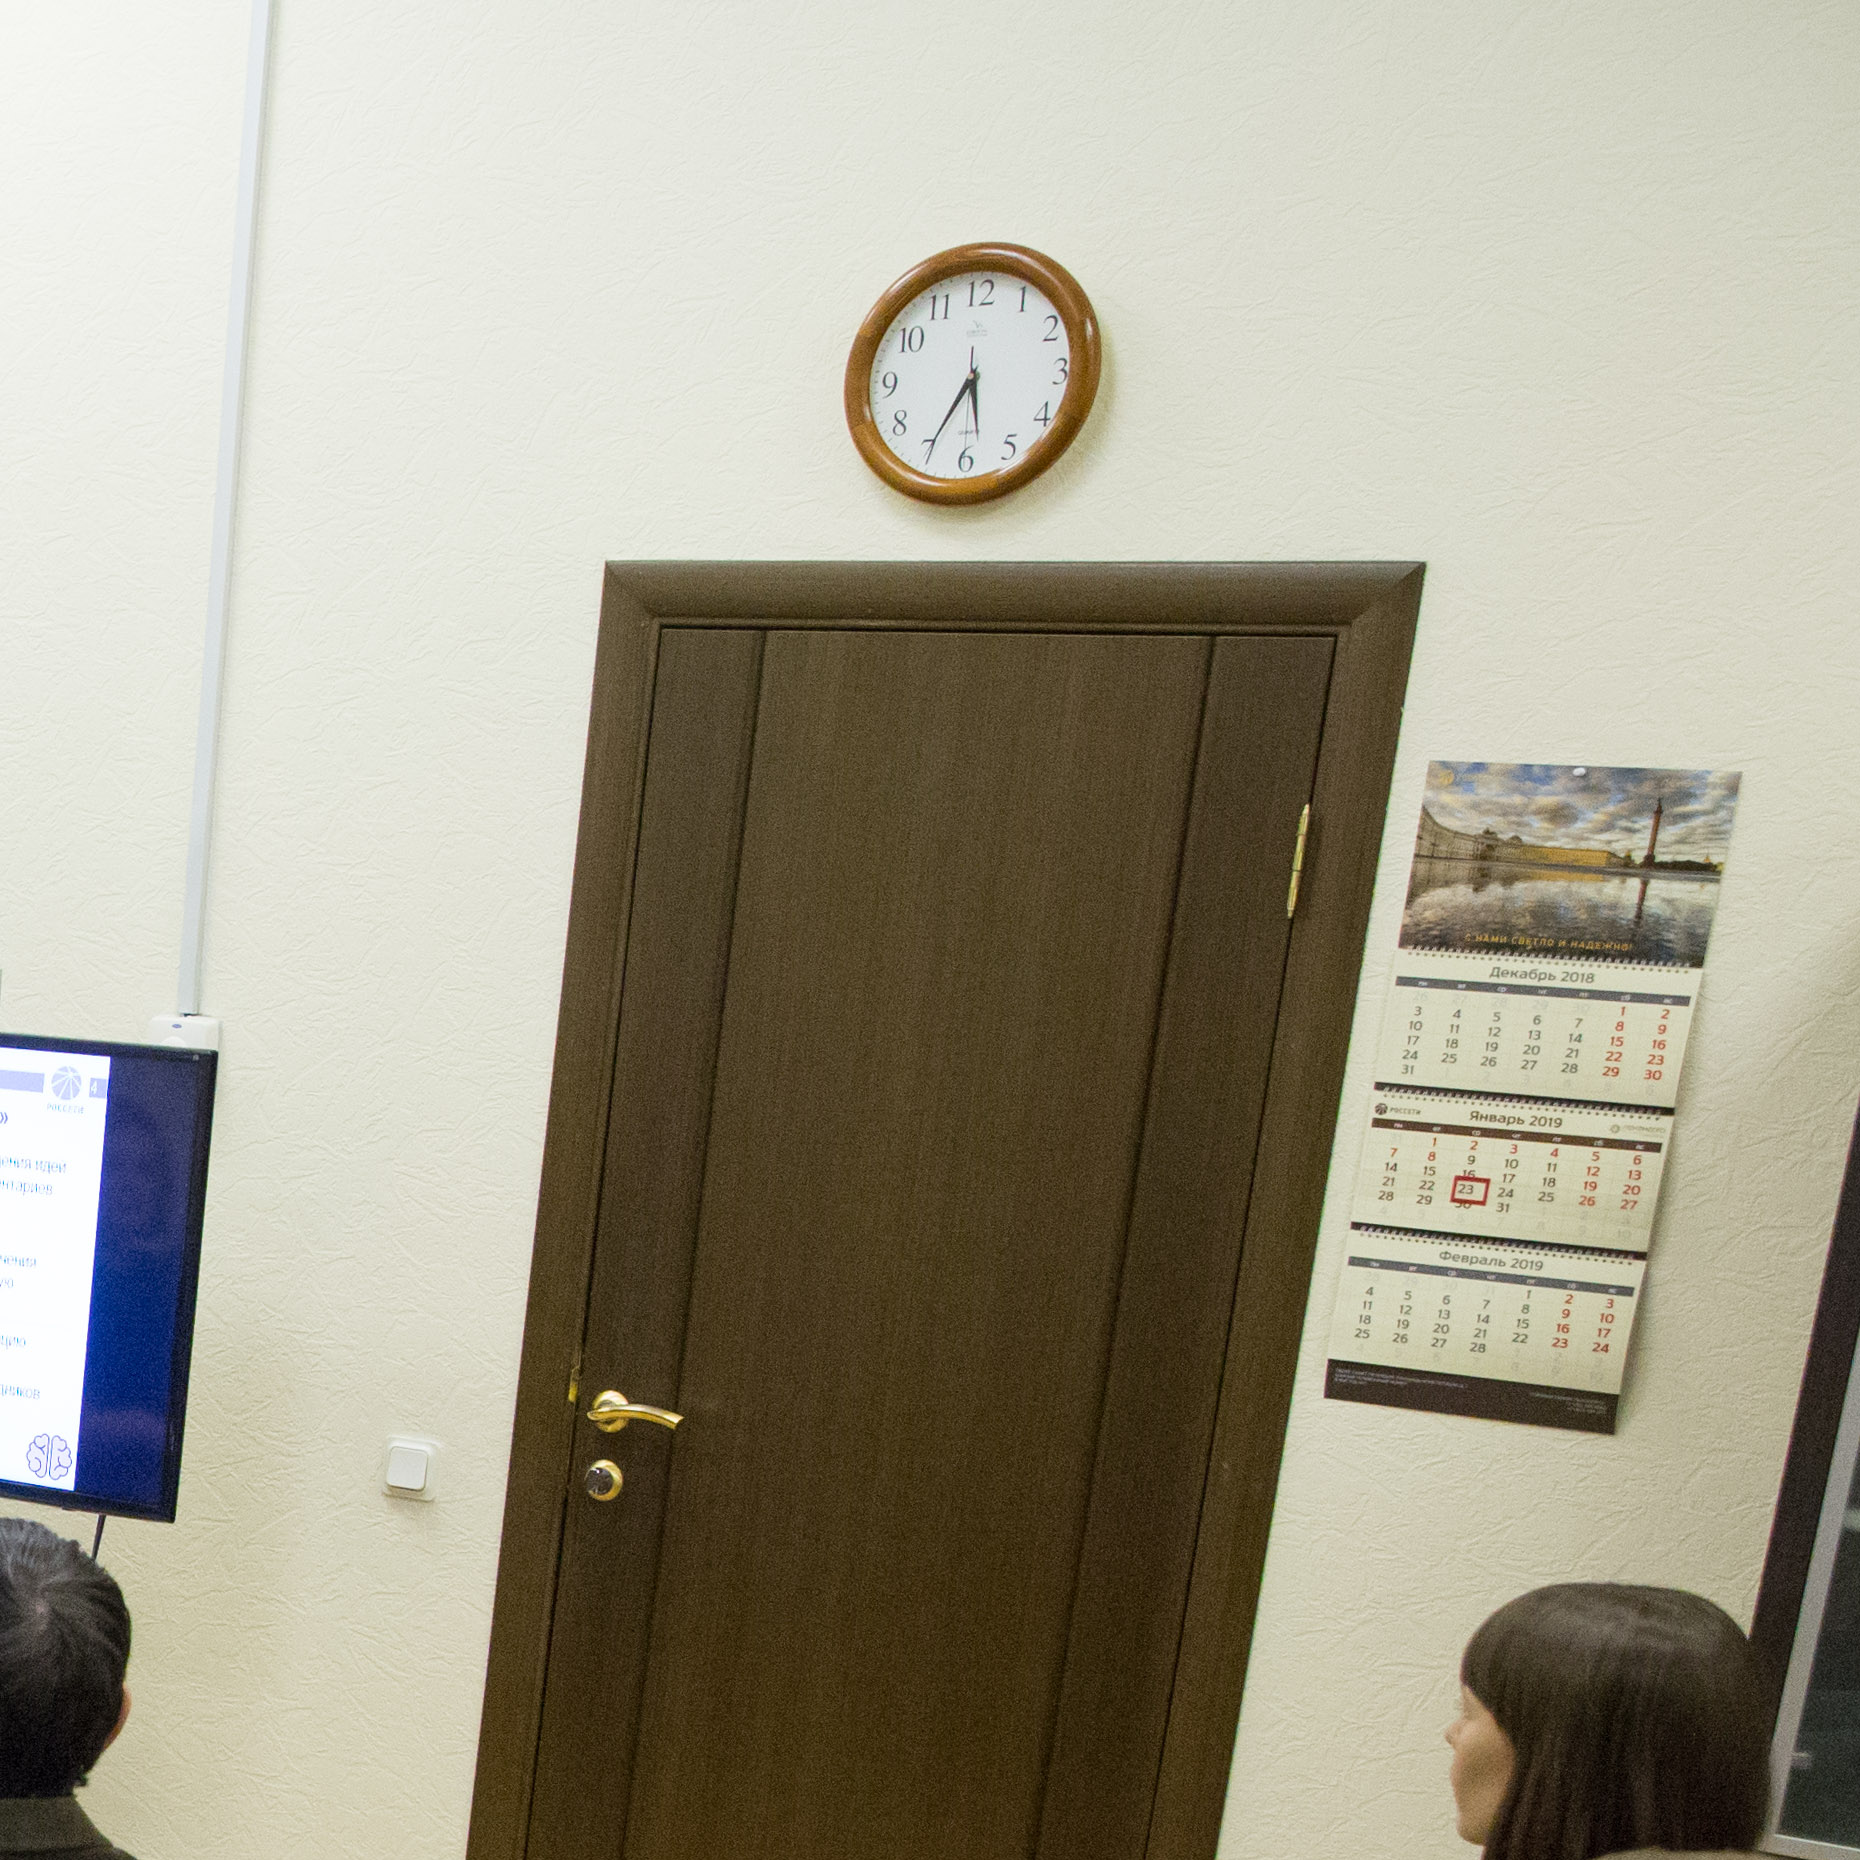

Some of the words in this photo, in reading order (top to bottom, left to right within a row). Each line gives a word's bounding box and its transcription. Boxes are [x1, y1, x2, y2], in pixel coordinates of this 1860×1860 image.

[967, 279, 995, 307] 12
[1019, 287, 1026, 312] 1
[930, 294, 950, 321] 11
[898, 326, 925, 353] 10
[1043, 315, 1058, 342] 2
[1052, 358, 1068, 385] 3
[882, 372, 898, 399] 9
[892, 410, 907, 436] 8
[1033, 401, 1050, 427] 4
[921, 439, 936, 465] 7
[958, 445, 973, 472] 6
[1001, 434, 1018, 460] 5
[1475, 933, 1507, 943] НАМИ
[1511, 936, 1554, 947] СВЕТЛО
[1558, 939, 1566, 947] И
[1489, 966, 1557, 982] Декабрь
[1560, 971, 1595, 983] 2018
[1414, 1006, 1422, 1016] 3
[1453, 1009, 1461, 1018] 4
[1492, 1012, 1501, 1022] 5
[1533, 1015, 1541, 1025] 6
[1575, 1018, 1583, 1028] 7
[1615, 1021, 1624, 1031] 8
[1658, 1024, 1667, 1034] 9
[1661, 1008, 1670, 1019] 2
[1409, 1020, 1422, 1031] 10
[1450, 1024, 1460, 1034] 11
[1488, 1027, 1501, 1037] 12
[1528, 1030, 1541, 1040] 13
[1569, 1033, 1582, 1043] 14
[1610, 1036, 1624, 1047] 15
[1652, 1039, 1666, 1050] 16
[1407, 1035, 1420, 1045] 17
[1445, 1038, 1458, 1049] 18
[1485, 1042, 1498, 1052] 19
[1523, 1044, 1540, 1055] 20
[1565, 1048, 1579, 1058] 21
[1605, 1051, 1622, 1062] 22
[1647, 1054, 1664, 1065] 23
[1401, 1064, 1414, 1075] 31
[1402, 1049, 1418, 1060] 24
[1441, 1053, 1457, 1064] 25
[1480, 1056, 1497, 1067] 26
[1521, 1060, 1537, 1070] 27
[1561, 1063, 1578, 1073] 28
[1602, 1066, 1619, 1077] 29
[1643, 1069, 1662, 1080] 30
[91, 1080, 98, 1095] 4
[1390, 1106, 1422, 1116] РОССЕТИ
[1469, 1110, 1525, 1127] Январь
[1528, 1115, 1563, 1129] 2019
[1390, 1148, 1398, 1157] 7
[1428, 1152, 1436, 1161] 8
[1467, 1155, 1475, 1165] 9
[1504, 1159, 1519, 1169] 10
[1547, 1163, 1557, 1173] 11
[1586, 1166, 1600, 1177] 12
[1628, 1170, 1642, 1180] 13
[1470, 1140, 1478, 1150] 2
[1509, 1144, 1518, 1154] 3
[1550, 1148, 1559, 1158] 4
[1592, 1151, 1600, 1161] 5
[1633, 1155, 1642, 1165] 6
[1385, 1162, 1398, 1172] 14
[1424, 1166, 1436, 1176] 15
[1502, 1174, 1516, 1183] 17
[1542, 1177, 1556, 1188] 18
[1583, 1181, 1597, 1192] 19
[1623, 1185, 1641, 1196] 20
[1378, 1190, 1394, 1201] 28
[1416, 1194, 1432, 1205] 29
[1496, 1202, 1510, 1213] 31
[1382, 1176, 1395, 1186] 21
[1419, 1180, 1435, 1191] 22
[1458, 1184, 1474, 1194] 23
[1497, 1187, 1514, 1198] 24
[1538, 1192, 1554, 1202] 25
[1579, 1195, 1596, 1207] 26
[1620, 1199, 1638, 1210] 27
[1439, 1250, 1506, 1267] Февраль
[1510, 1258, 1544, 1271] 2019
[1365, 1287, 1374, 1296] 4
[1404, 1291, 1412, 1300] 5
[1442, 1295, 1451, 1305] 6
[1483, 1299, 1490, 1309] 7
[1521, 1304, 1530, 1314] 8
[1562, 1308, 1571, 1319] 9
[1600, 1313, 1615, 1324] 10
[1564, 1294, 1574, 1304] 2
[1606, 1298, 1614, 1309] 3
[1363, 1300, 1373, 1310] 11
[1400, 1304, 1412, 1315] 12
[1438, 1309, 1451, 1320] 13
[1477, 1314, 1490, 1324] 14
[1517, 1318, 1529, 1329] 15
[1556, 1323, 1570, 1334] 16
[1598, 1328, 1611, 1338] 17
[1354, 1328, 1370, 1339] 25
[1392, 1332, 1408, 1344] 26
[1431, 1337, 1447, 1348] 27
[1469, 1342, 1486, 1353] 28
[1359, 1314, 1371, 1325] 18
[1397, 1319, 1410, 1329] 19
[1433, 1323, 1450, 1334] 20
[1474, 1328, 1487, 1339] 21
[1512, 1333, 1529, 1344] 22
[1552, 1337, 1569, 1349] 23
[1592, 1342, 1610, 1353] 24
